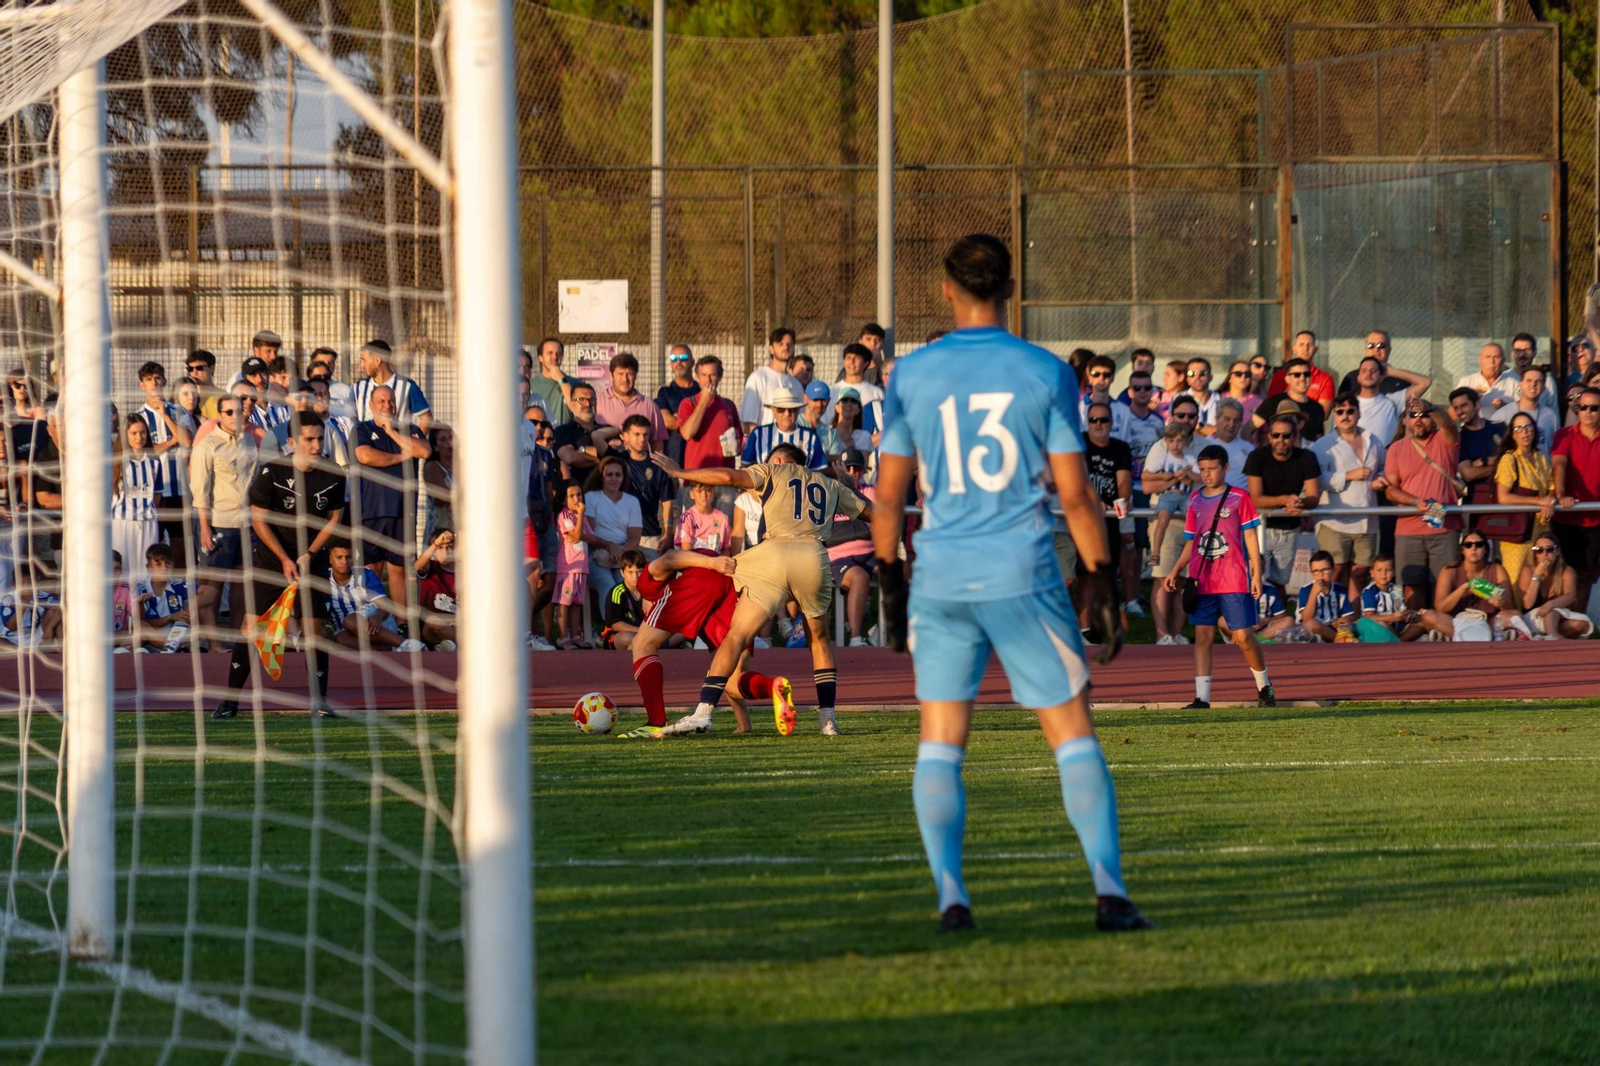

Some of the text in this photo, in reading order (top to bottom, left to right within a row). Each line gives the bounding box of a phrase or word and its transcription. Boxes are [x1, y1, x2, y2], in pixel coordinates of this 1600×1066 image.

[578, 349, 611, 361] PADEL
[938, 392, 1018, 494] 13
[787, 477, 827, 526] 19
